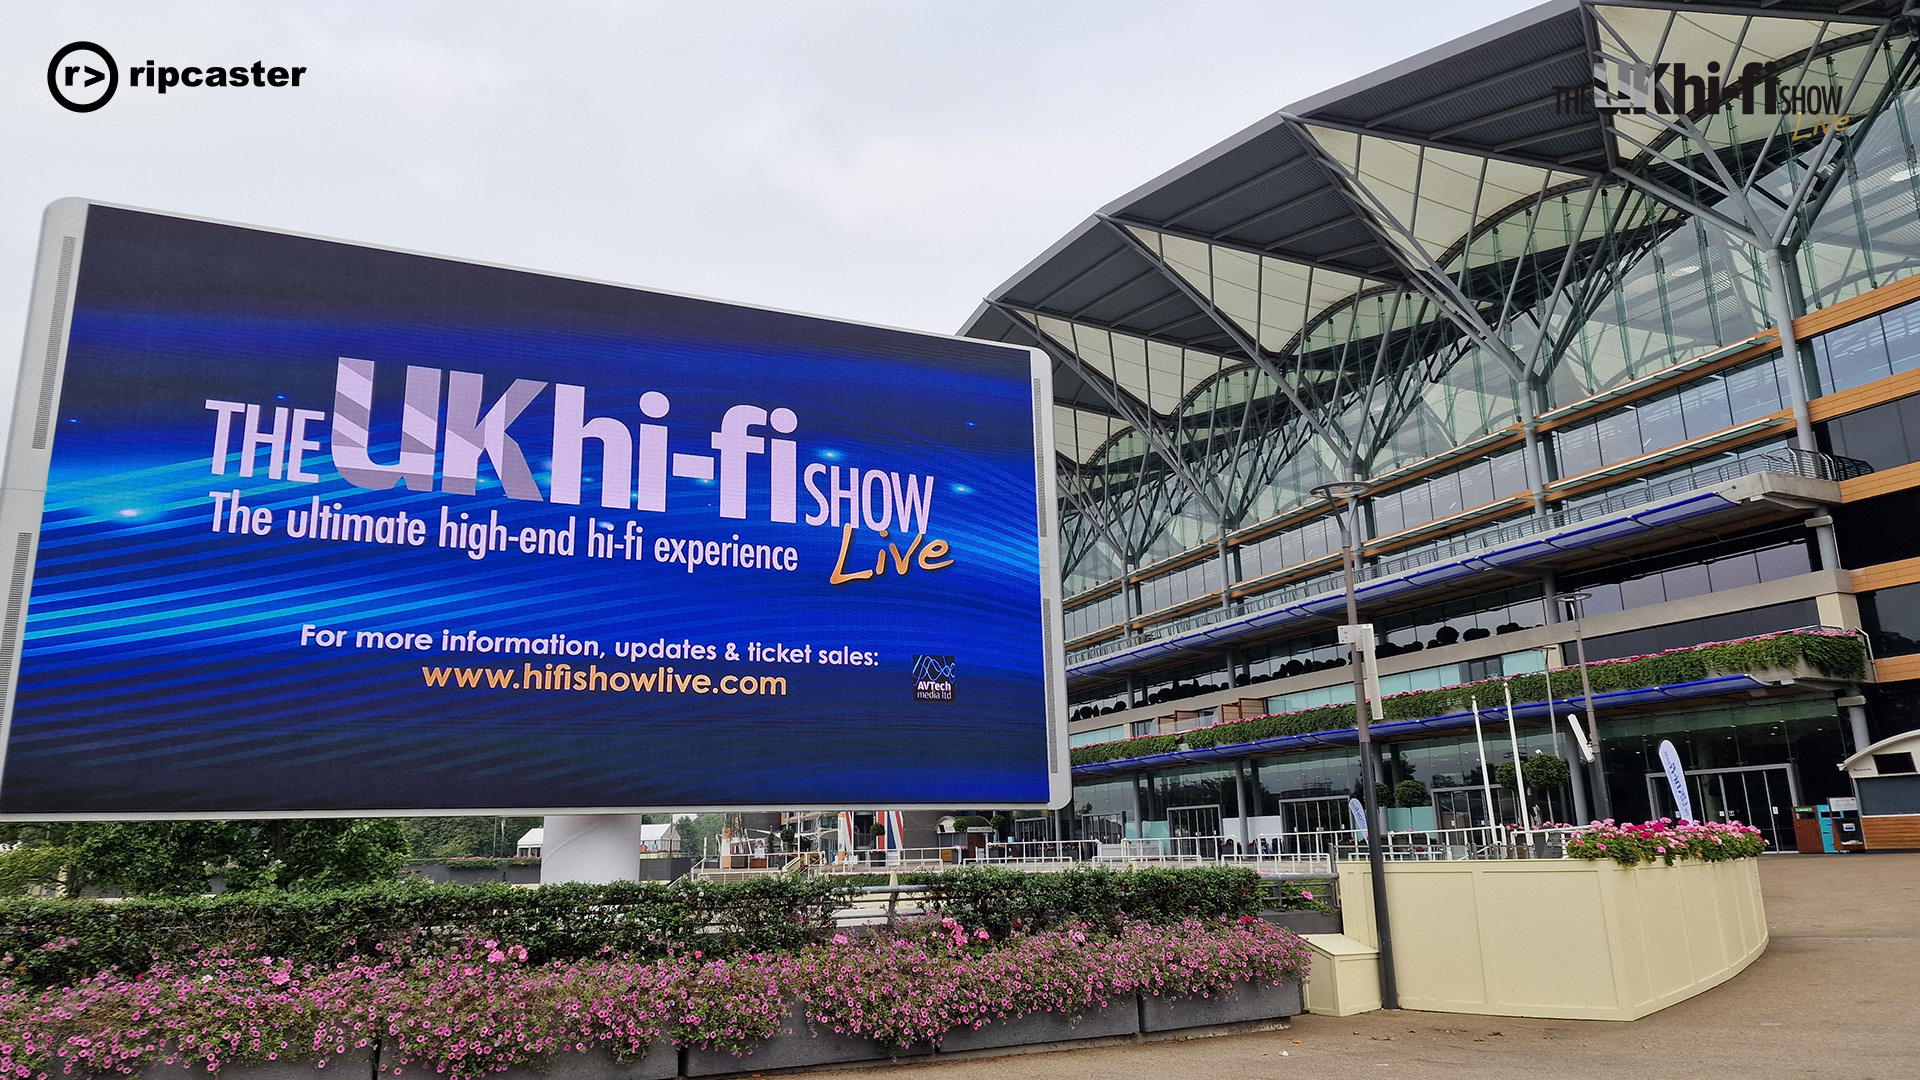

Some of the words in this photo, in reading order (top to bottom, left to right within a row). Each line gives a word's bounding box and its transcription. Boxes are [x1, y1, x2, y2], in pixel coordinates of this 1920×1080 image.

[204, 399, 325, 484] THE
[803, 462, 935, 535] SHOW
[208, 489, 273, 536] The
[286, 495, 426, 546] ultimate
[438, 505, 576, 560] high-end
[587, 517, 643, 561] hi-fi
[653, 533, 799, 574] experience
[829, 522, 955, 585] Live
[300, 623, 348, 648] For
[355, 629, 434, 651] more
[441, 628, 606, 660] information,
[614, 637, 718, 663] updates
[724, 642, 741, 662] &
[747, 641, 812, 665] ticket
[818, 645, 880, 668] sales:
[421, 662, 788, 697] www.hifishowlive.com
[917, 680, 952, 692] AVTech
[917, 690, 941, 700] media
[941, 690, 952, 700] ltd
